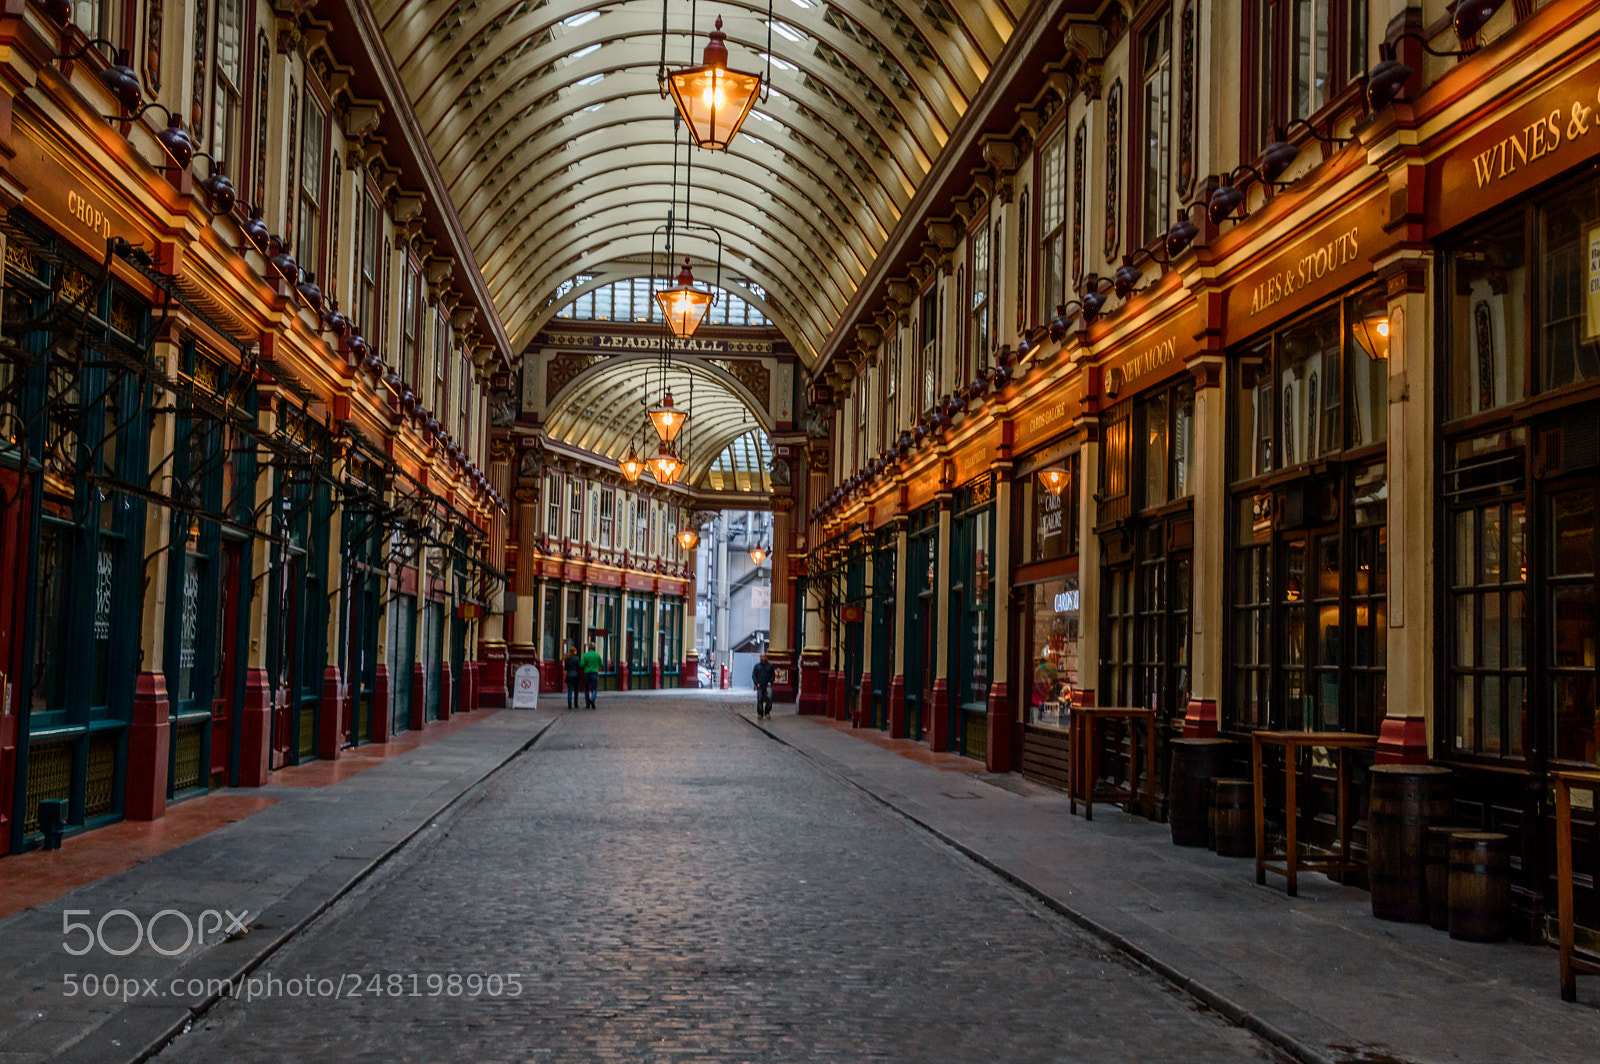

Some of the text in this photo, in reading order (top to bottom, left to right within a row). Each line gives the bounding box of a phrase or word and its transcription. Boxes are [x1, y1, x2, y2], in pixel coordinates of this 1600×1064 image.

[1472, 109, 1560, 189] WINES
[1566, 101, 1592, 140] &
[69, 190, 110, 240] CHOP'D
[1250, 227, 1358, 316] ALES & STOUTS
[1121, 336, 1176, 386] NEW MOON
